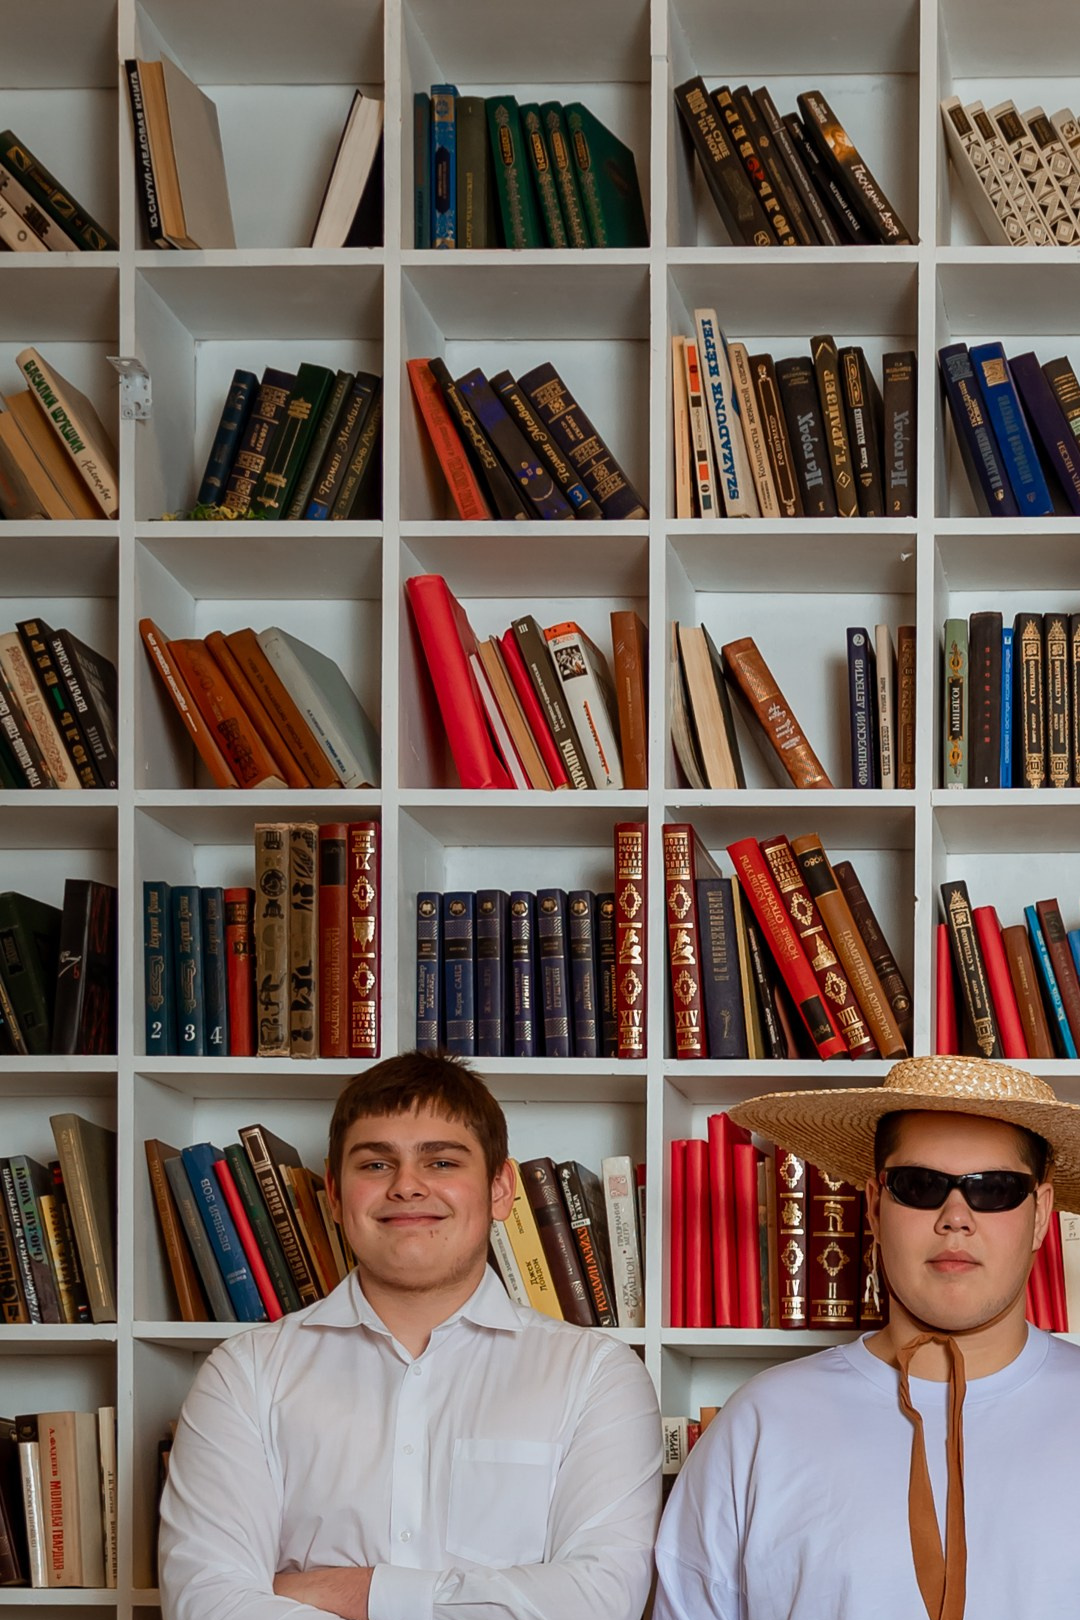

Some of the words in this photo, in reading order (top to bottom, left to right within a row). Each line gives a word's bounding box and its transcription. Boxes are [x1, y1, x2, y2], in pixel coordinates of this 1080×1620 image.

[130, 70, 143, 109] КНИГА
[702, 133, 723, 162] МОРЕ
[703, 114, 717, 131] НА
[710, 128, 731, 158] СУШЕ
[697, 318, 721, 377] KÉPEI
[20, 358, 59, 408] ВАСИЛИЙ
[48, 406, 87, 454] ШУКШИН
[507, 391, 548, 445] Мелвилл
[316, 453, 345, 496] Герман
[332, 395, 369, 452] Мелвилл
[708, 382, 741, 500] SZÁZADUNK
[795, 411, 821, 459] горах
[892, 410, 910, 456] горах
[539, 441, 573, 484] Герман
[802, 459, 824, 489] На
[890, 460, 908, 488] На
[1054, 439, 1076, 473] ПЕСЕН
[574, 490, 583, 501] 3
[893, 501, 901, 511] 2
[49, 638, 76, 677] МУЗЫКЕ
[855, 635, 862, 644] 2
[65, 677, 89, 713] ВЕРЬТЕ
[853, 658, 866, 708] ДЕТЕКТИВ
[952, 687, 960, 730] ЮДЕНИЧ
[855, 711, 869, 784] ФРАНЦУЗСКИЙ
[24, 765, 41, 787] ГРАФ
[737, 854, 768, 901] КУЛЬТУРЫ
[753, 871, 788, 924] ОТКРЫТИЯ
[777, 925, 803, 960] НОВЫЕ
[836, 928, 880, 992] ПАМЯТНИКИ
[862, 991, 898, 1041] КУЛЬТУРЫ
[151, 1022, 162, 1039] 2
[184, 1024, 196, 1041] 3
[210, 1026, 223, 1044] 4
[620, 1010, 641, 1025] XIV
[676, 1010, 698, 1026] XIV
[838, 1007, 857, 1026] VIII
[199, 1177, 216, 1203] ЗОВ
[207, 1204, 232, 1252] ВЕЧНЫЙ
[522, 1260, 538, 1285] Джек
[623, 1257, 639, 1308] СИМЕНОН
[785, 1279, 799, 1297] IV
[828, 1282, 836, 1299] II
[49, 1480, 62, 1526] МОЛОДАЯ
[51, 1529, 64, 1570] ГВАРДИЯ
